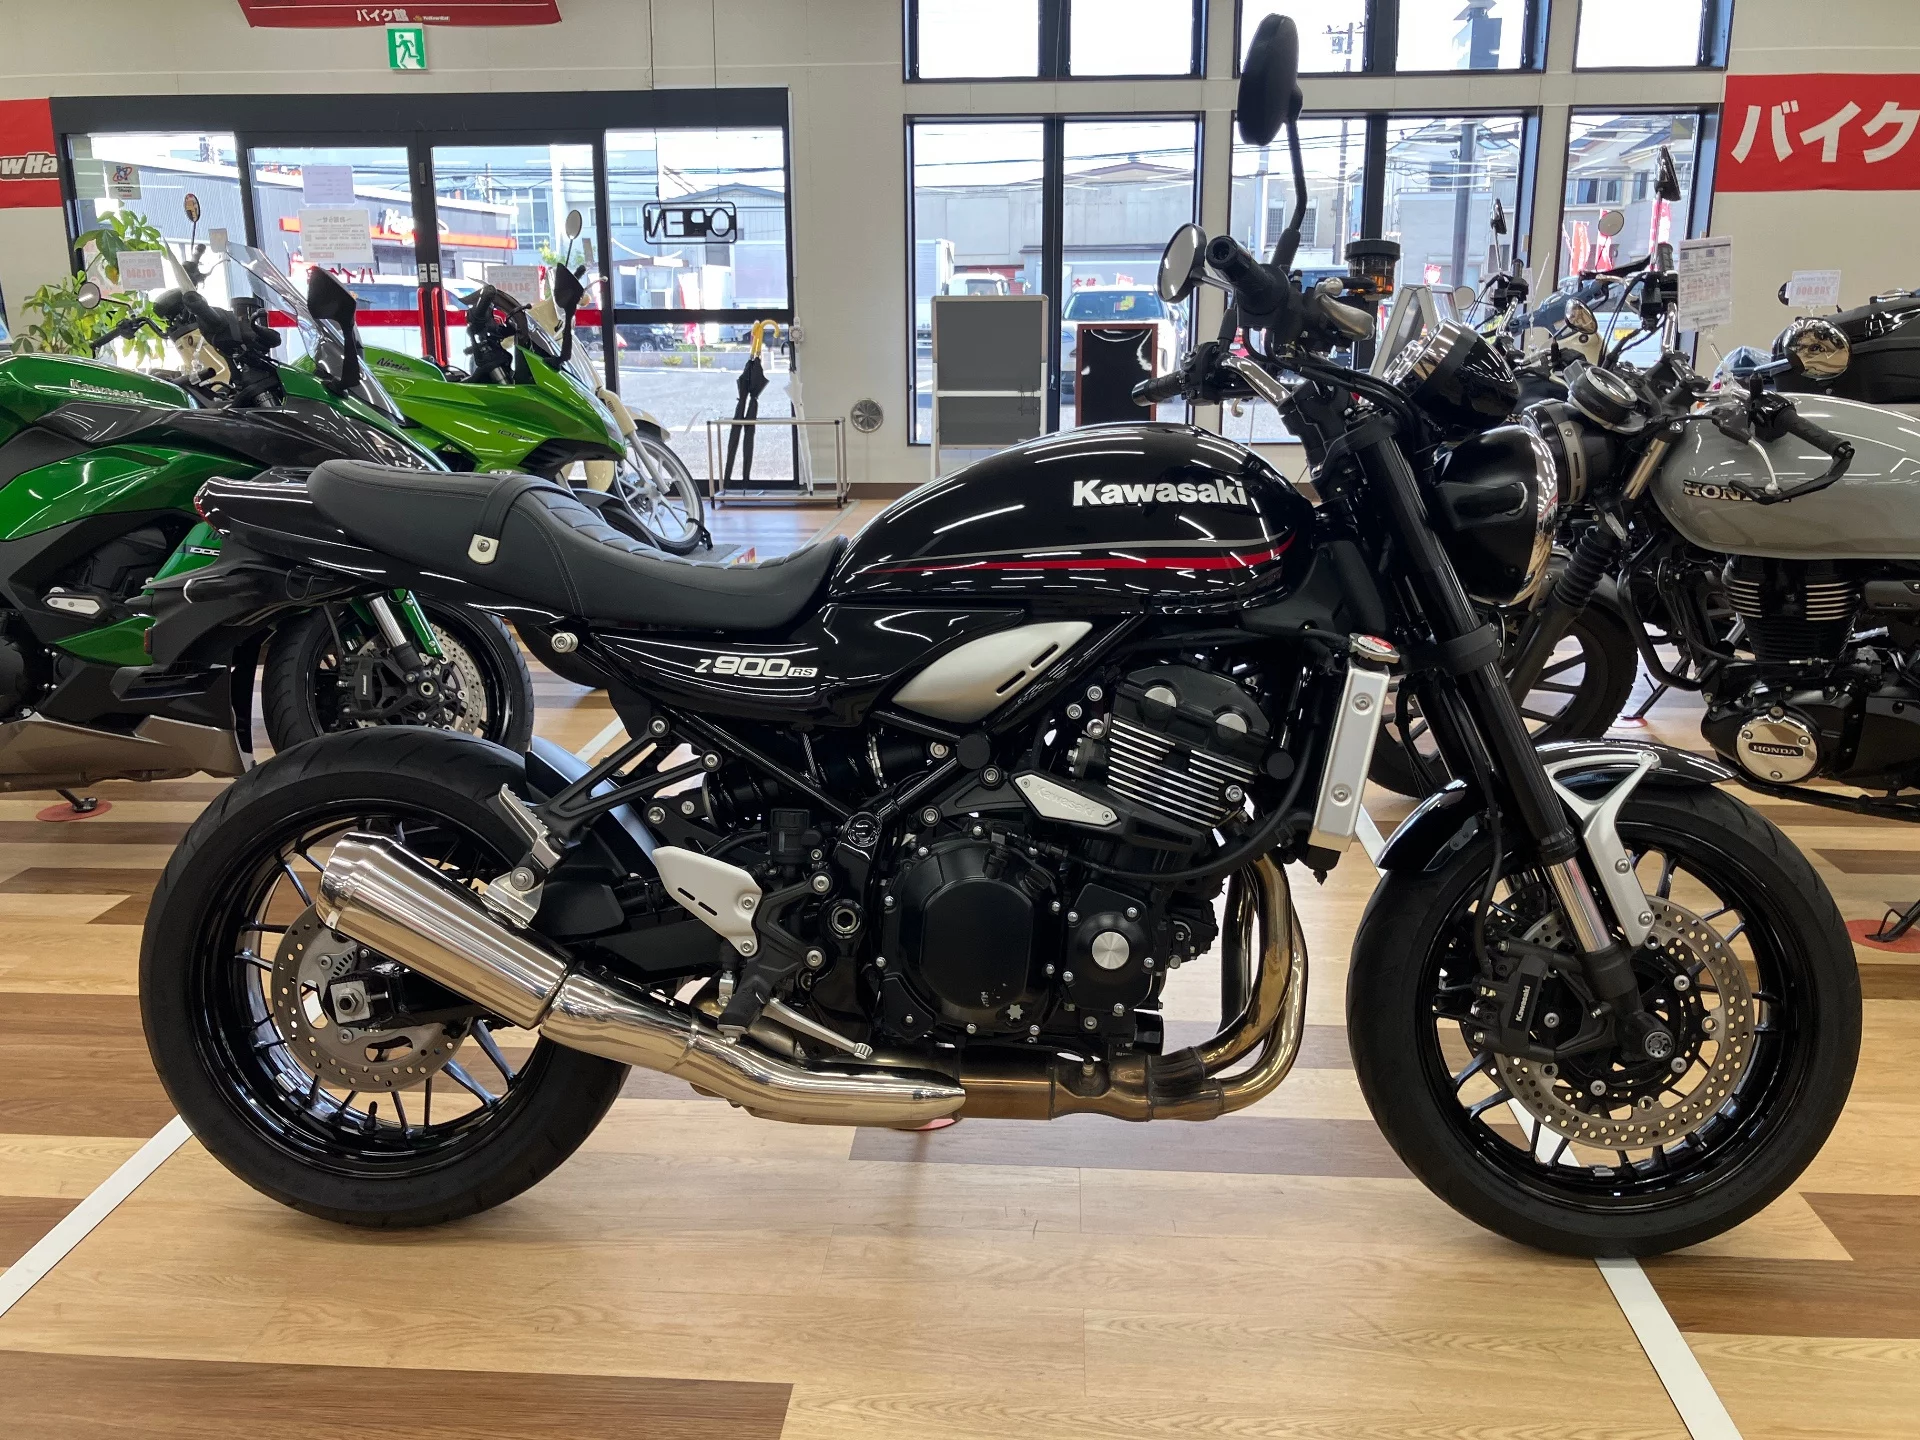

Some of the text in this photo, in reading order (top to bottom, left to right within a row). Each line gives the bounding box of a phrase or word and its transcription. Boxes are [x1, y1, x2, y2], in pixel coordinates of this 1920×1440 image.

[1730, 100, 1920, 164] バイク
[69, 378, 144, 400] Kawasaki
[1072, 479, 1248, 507] Kawasaki
[1753, 744, 1798, 756] HONDA
[1515, 985, 1531, 1022] Kawasaki
